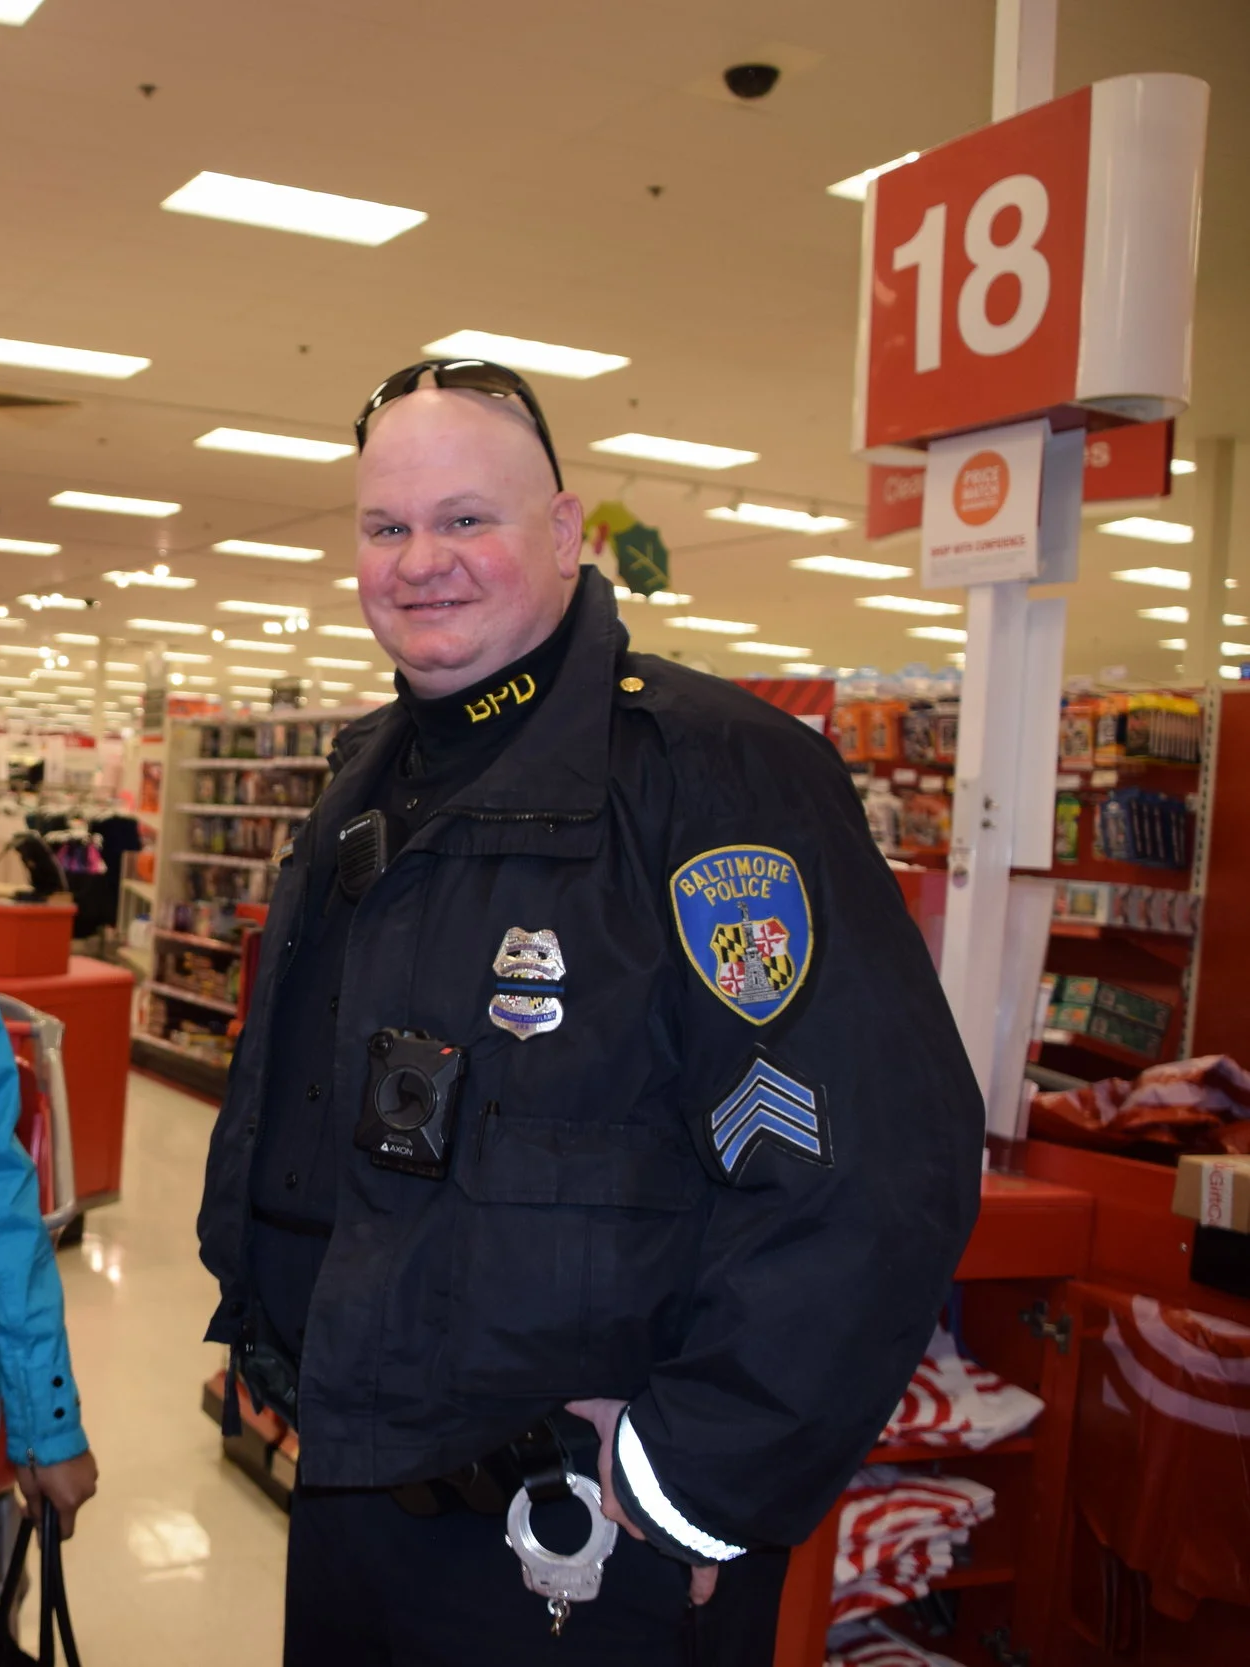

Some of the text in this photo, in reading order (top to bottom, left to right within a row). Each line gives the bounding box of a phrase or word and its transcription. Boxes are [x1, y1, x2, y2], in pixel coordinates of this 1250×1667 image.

[892, 173, 1050, 375] 18
[463, 673, 536, 722] BPD
[678, 856, 792, 897] BALTIMORE
[703, 877, 772, 906] POLICE
[390, 1144, 413, 1157] AXON
